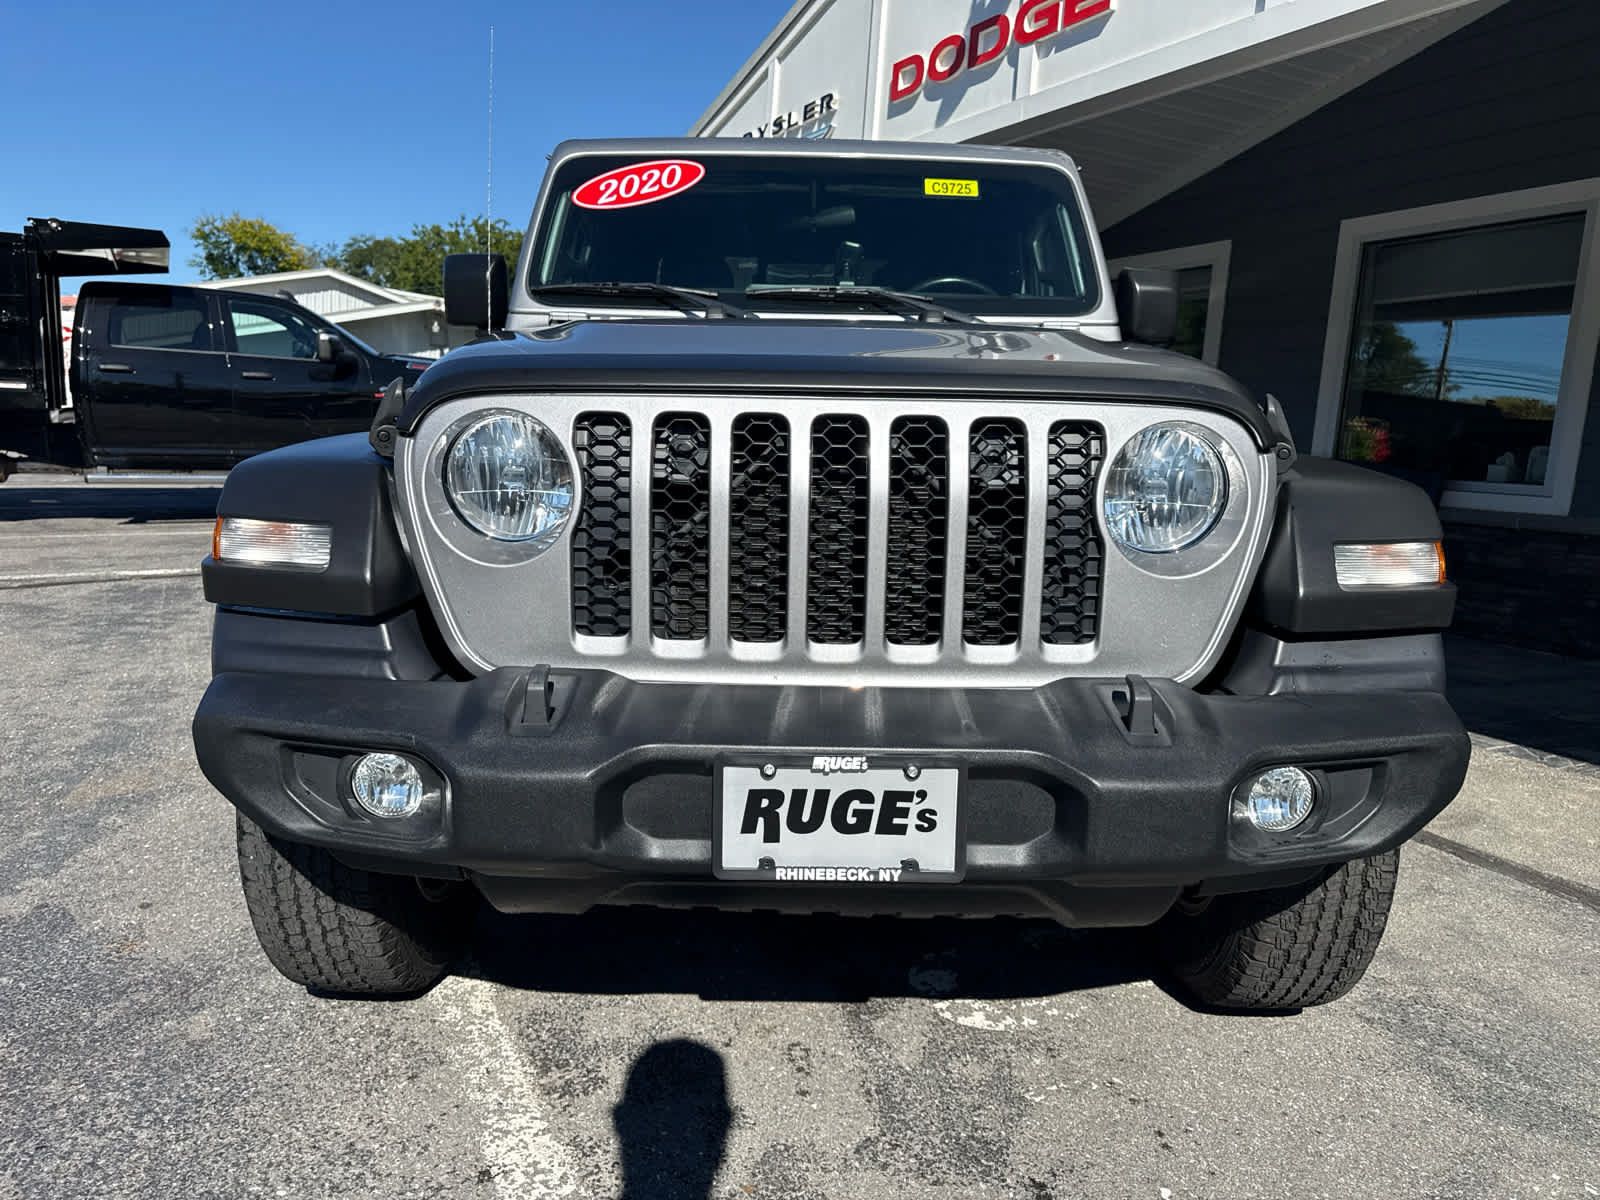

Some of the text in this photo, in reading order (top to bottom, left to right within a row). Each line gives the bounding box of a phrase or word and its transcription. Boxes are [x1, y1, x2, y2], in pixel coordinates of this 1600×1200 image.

[597, 165, 682, 204] 2020
[932, 182, 971, 194] C9725
[740, 788, 938, 843] RUGE's
[775, 867, 902, 882] RHINEBECK, NY
